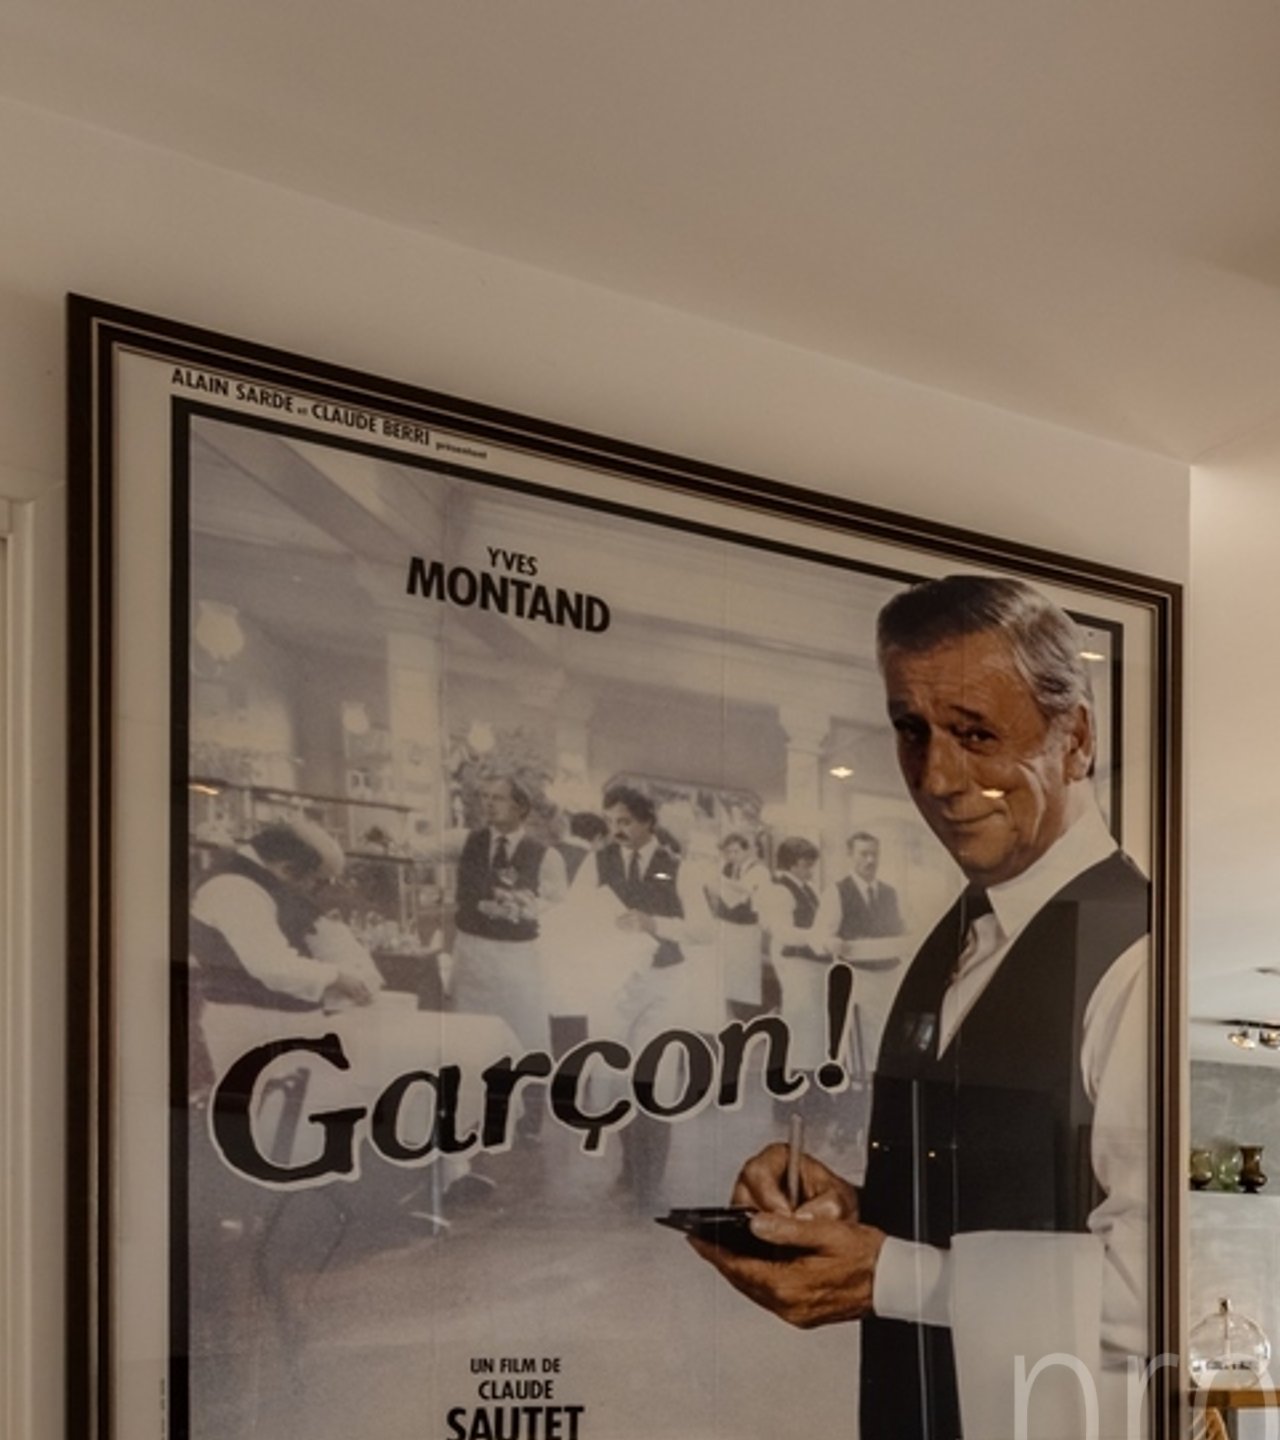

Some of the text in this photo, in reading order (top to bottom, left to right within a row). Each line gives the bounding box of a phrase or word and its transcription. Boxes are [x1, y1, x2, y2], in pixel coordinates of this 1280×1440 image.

[171, 367, 229, 396] ALAIN
[235, 383, 294, 413] SARDE
[311, 403, 376, 433] CLAUDE
[383, 420, 430, 446] BERRI
[488, 547, 538, 576] YVES
[406, 557, 610, 633] MONTAND
[212, 964, 853, 1184] Garçon!
[471, 1358, 561, 1374] UN FILM DE
[478, 1380, 553, 1400] CLAUDE
